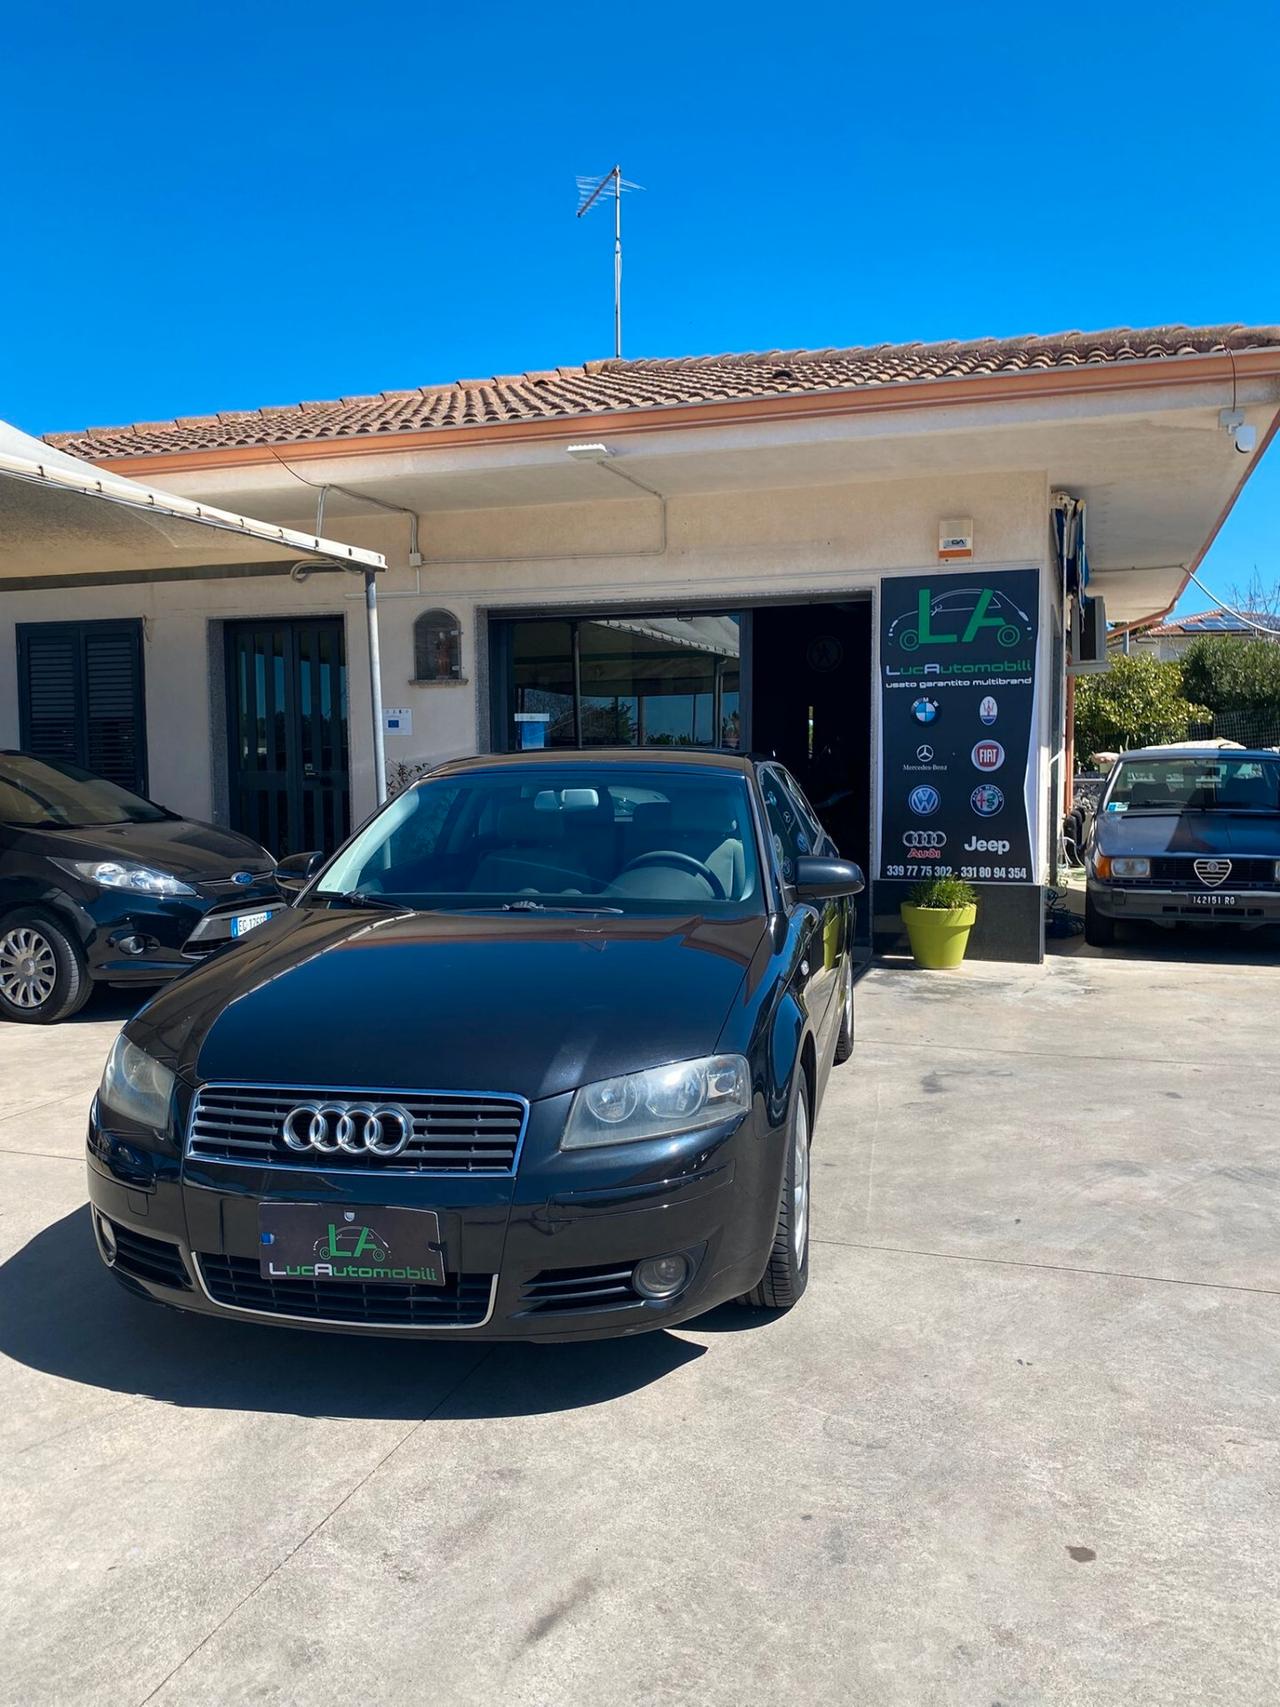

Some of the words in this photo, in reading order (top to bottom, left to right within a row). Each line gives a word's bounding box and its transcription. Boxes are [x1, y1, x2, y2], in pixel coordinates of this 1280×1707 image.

[918, 588, 1006, 644] LA
[886, 660, 1032, 676] LucAutomobili
[886, 681, 917, 689] usato
[919, 679, 970, 689] garantito
[972, 676, 1032, 686] multibrand
[979, 749, 998, 762] FIAT
[903, 764, 947, 772] Mercedes-Benz
[964, 836, 1010, 855] Jeep
[907, 848, 941, 859] Audi
[886, 865, 904, 876] 339
[906, 865, 918, 876] 77
[920, 865, 932, 876] 75
[934, 866, 953, 877] 302
[960, 866, 977, 878] 331
[979, 867, 991, 878] 80
[993, 867, 1006, 878] 94
[1008, 868, 1027, 879] 354
[328, 1223, 377, 1258] LA
[269, 1262, 438, 1281] LucAutomobili
